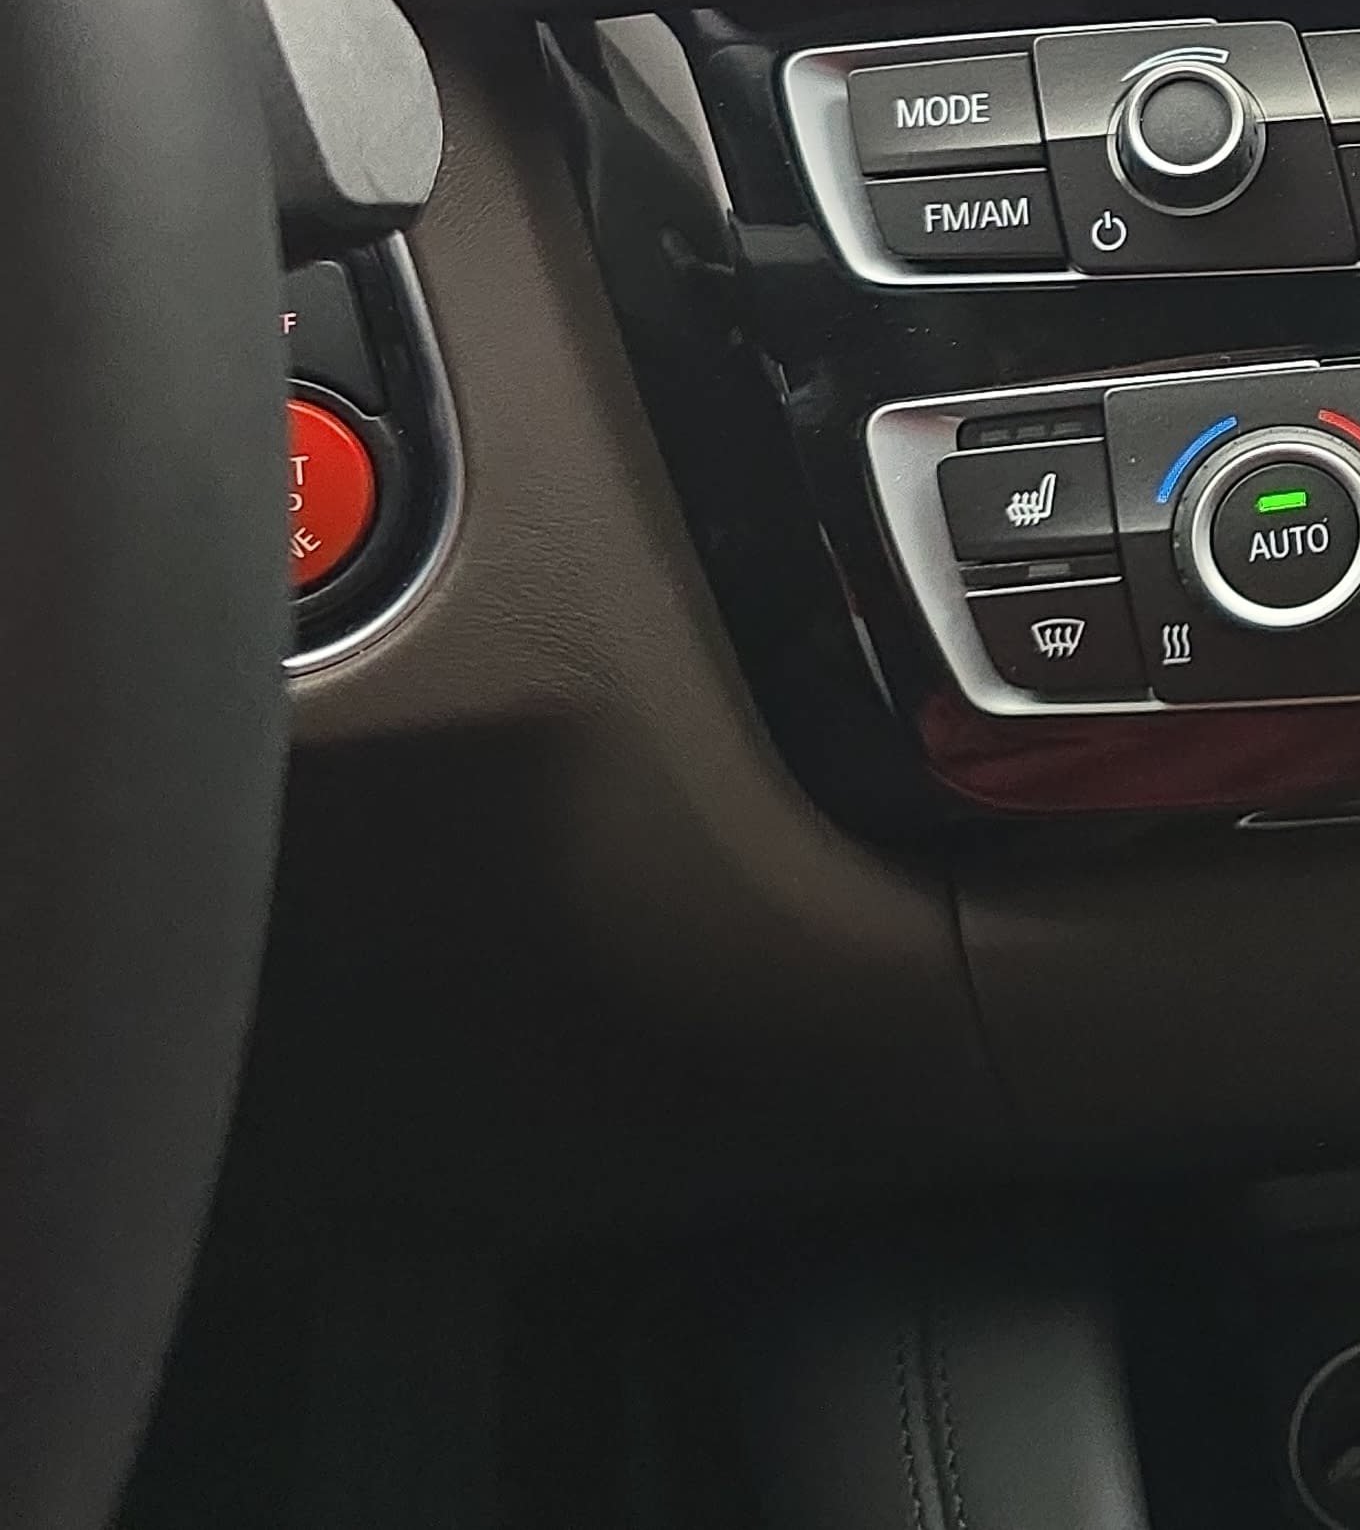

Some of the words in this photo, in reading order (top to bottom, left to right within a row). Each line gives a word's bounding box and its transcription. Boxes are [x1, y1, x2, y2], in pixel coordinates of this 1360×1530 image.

[897, 93, 991, 129] MODE
[923, 197, 1030, 234] FM/AM
[1249, 522, 1330, 562] AUTO
